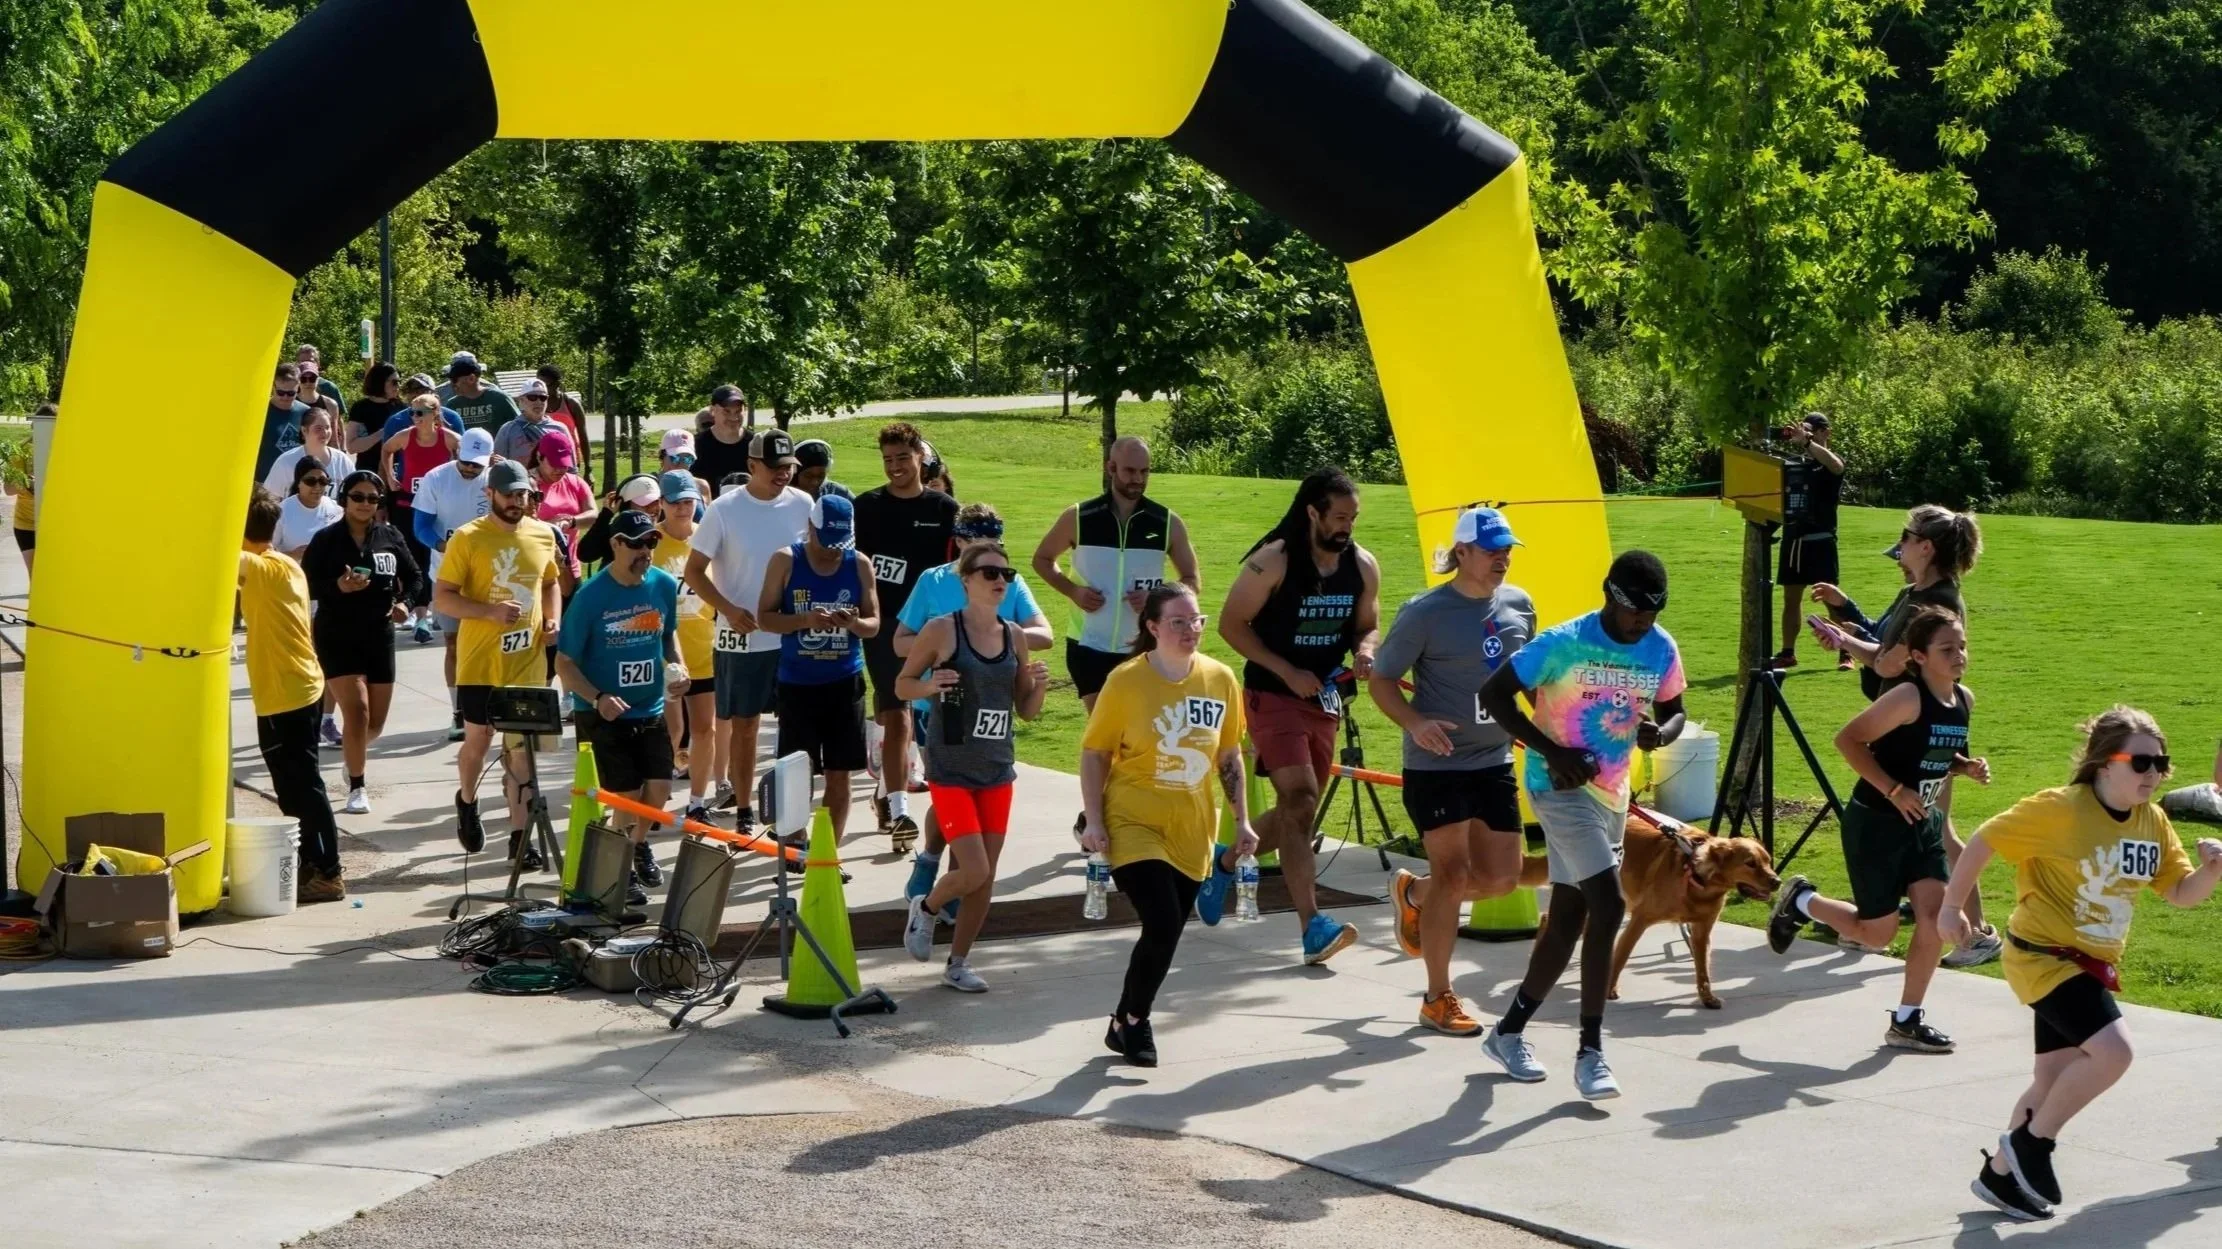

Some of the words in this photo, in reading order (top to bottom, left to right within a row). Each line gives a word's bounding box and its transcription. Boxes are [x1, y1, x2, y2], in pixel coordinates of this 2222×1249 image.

[873, 555, 905, 580] 557
[502, 630, 530, 652] 571
[718, 629, 748, 650] 554
[621, 662, 652, 685] 520
[1574, 668, 1660, 690] TENNESSEE
[977, 712, 1006, 737] 521
[1189, 699, 1224, 729] 567
[2122, 842, 2159, 877] 568
